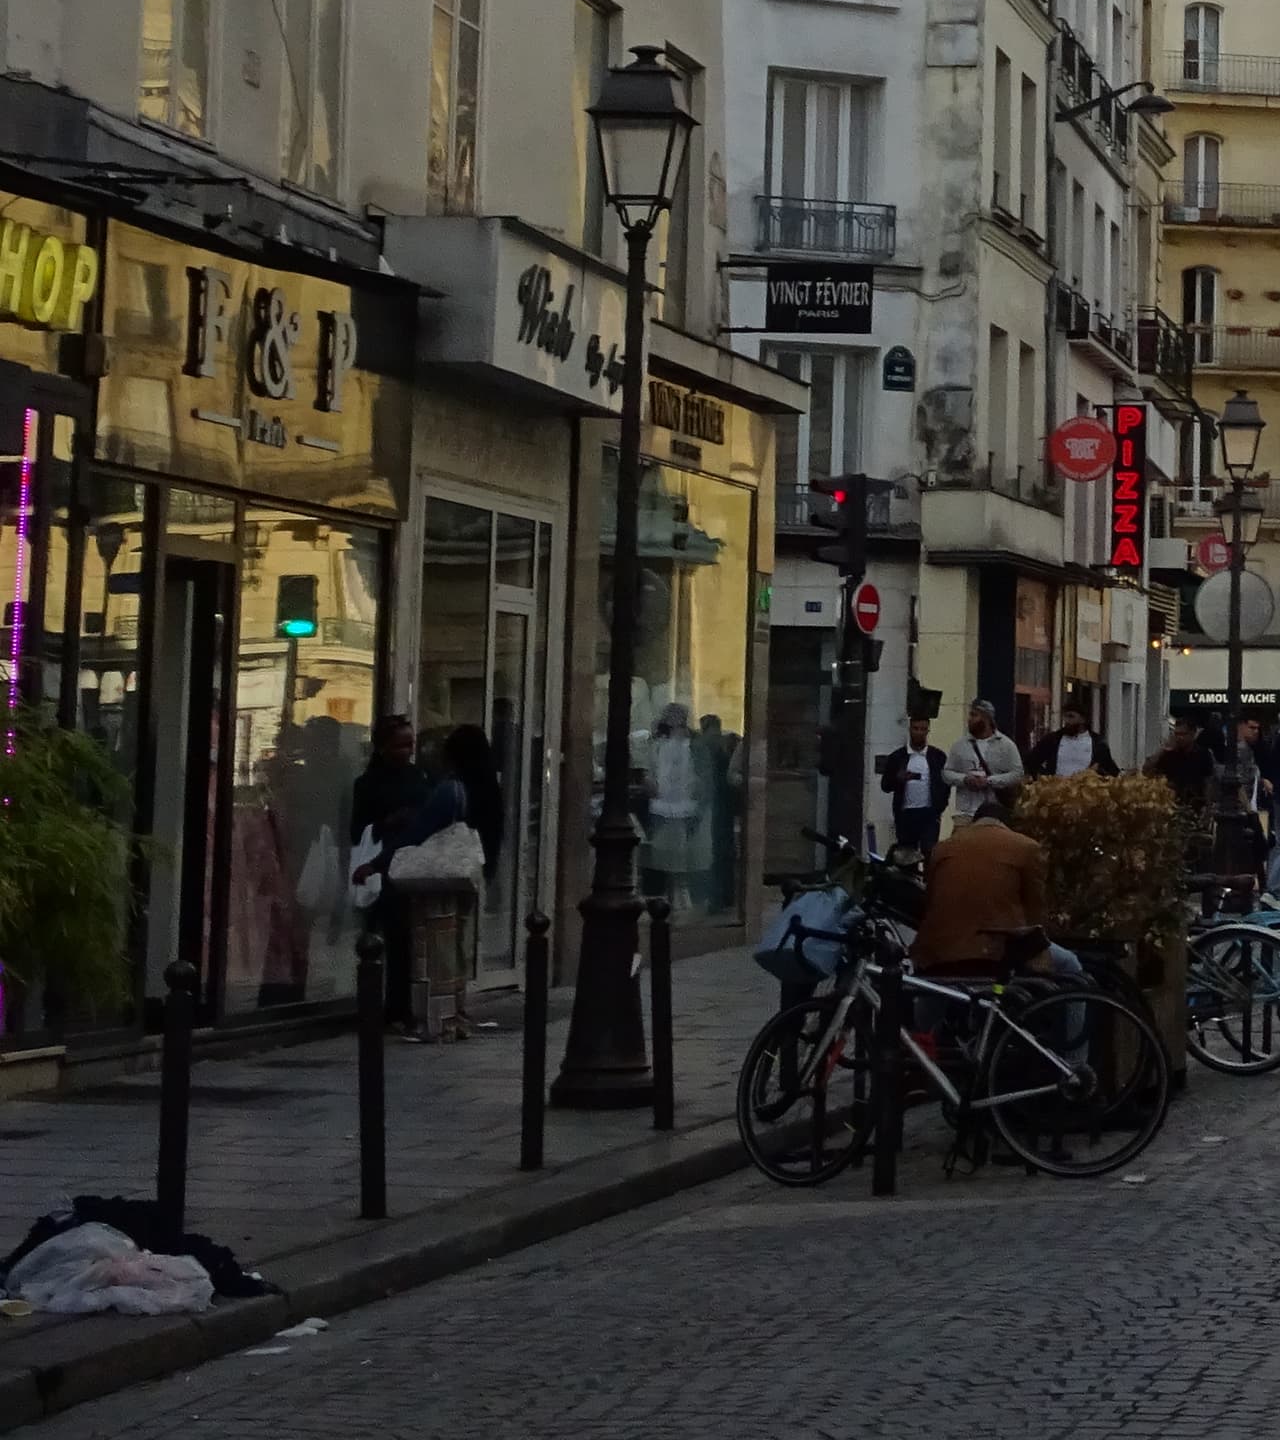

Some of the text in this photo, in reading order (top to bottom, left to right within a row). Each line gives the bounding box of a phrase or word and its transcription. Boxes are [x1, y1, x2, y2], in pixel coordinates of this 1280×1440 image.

[769, 277, 870, 307] VINGT FÉVRIER
[798, 310, 840, 318] PARIS
[1111, 406, 1142, 566] PIZZA
[1240, 693, 1276, 704] VACHE
